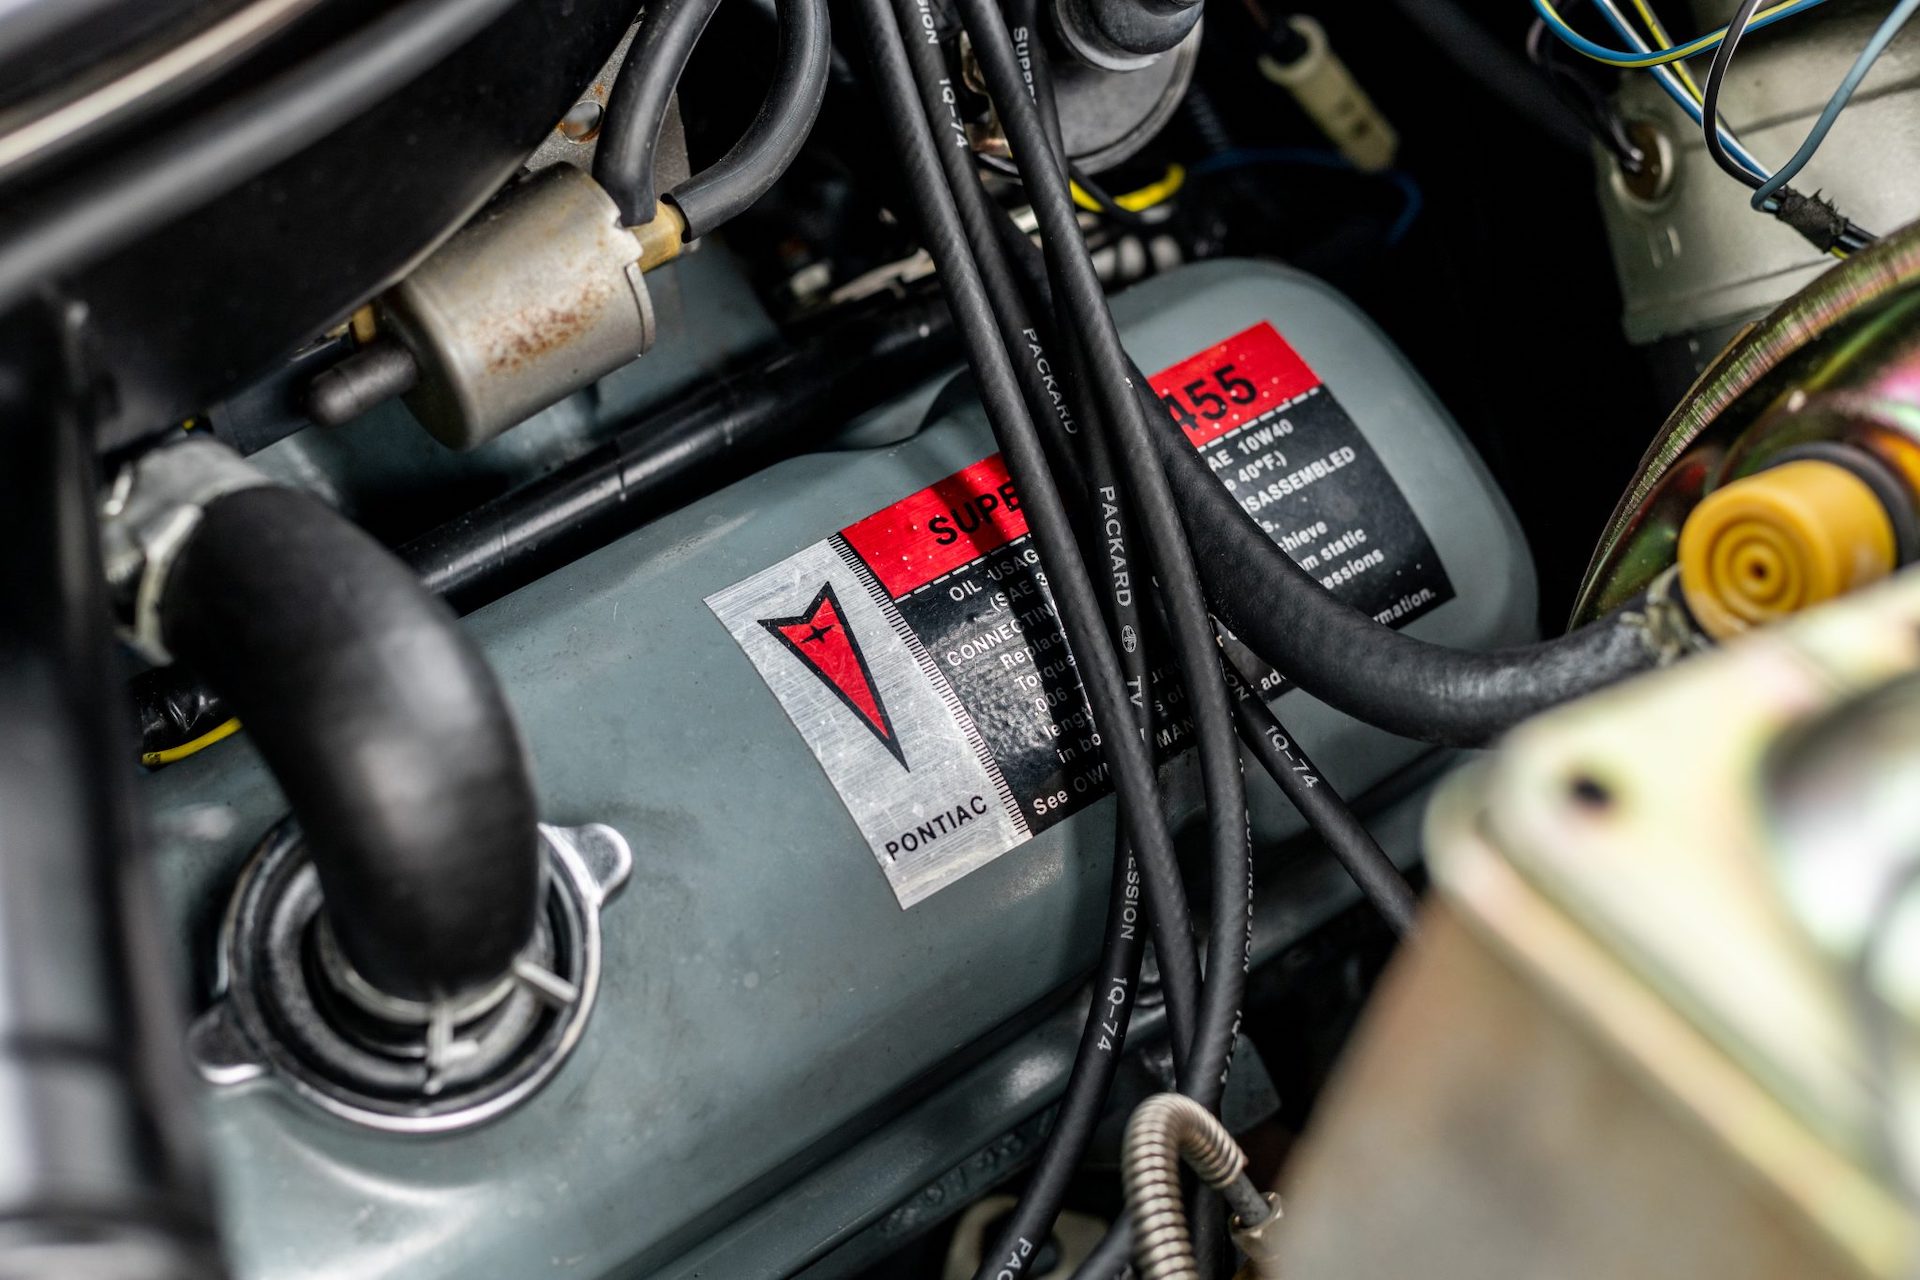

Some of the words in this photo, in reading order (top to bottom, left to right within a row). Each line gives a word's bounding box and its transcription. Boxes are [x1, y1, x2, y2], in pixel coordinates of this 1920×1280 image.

[1022, 327, 1078, 435] PACKARD
[949, 579, 983, 602] OIL
[1237, 418, 1294, 455] 10W40
[1100, 485, 1132, 607] PACKARD
[990, 579, 1034, 613] (SAE
[1034, 687, 1068, 717] .006
[1320, 527, 1368, 561] static
[947, 601, 1057, 667] CONNECTIN
[1043, 705, 1093, 741] lengt
[1319, 548, 1385, 591] essions
[1014, 654, 1076, 692] Torque
[1265, 724, 1320, 789] 1Q-74
[885, 795, 987, 862] PONTIAC
[1032, 789, 1069, 816] See
[1097, 976, 1128, 1052] 1Q-74
